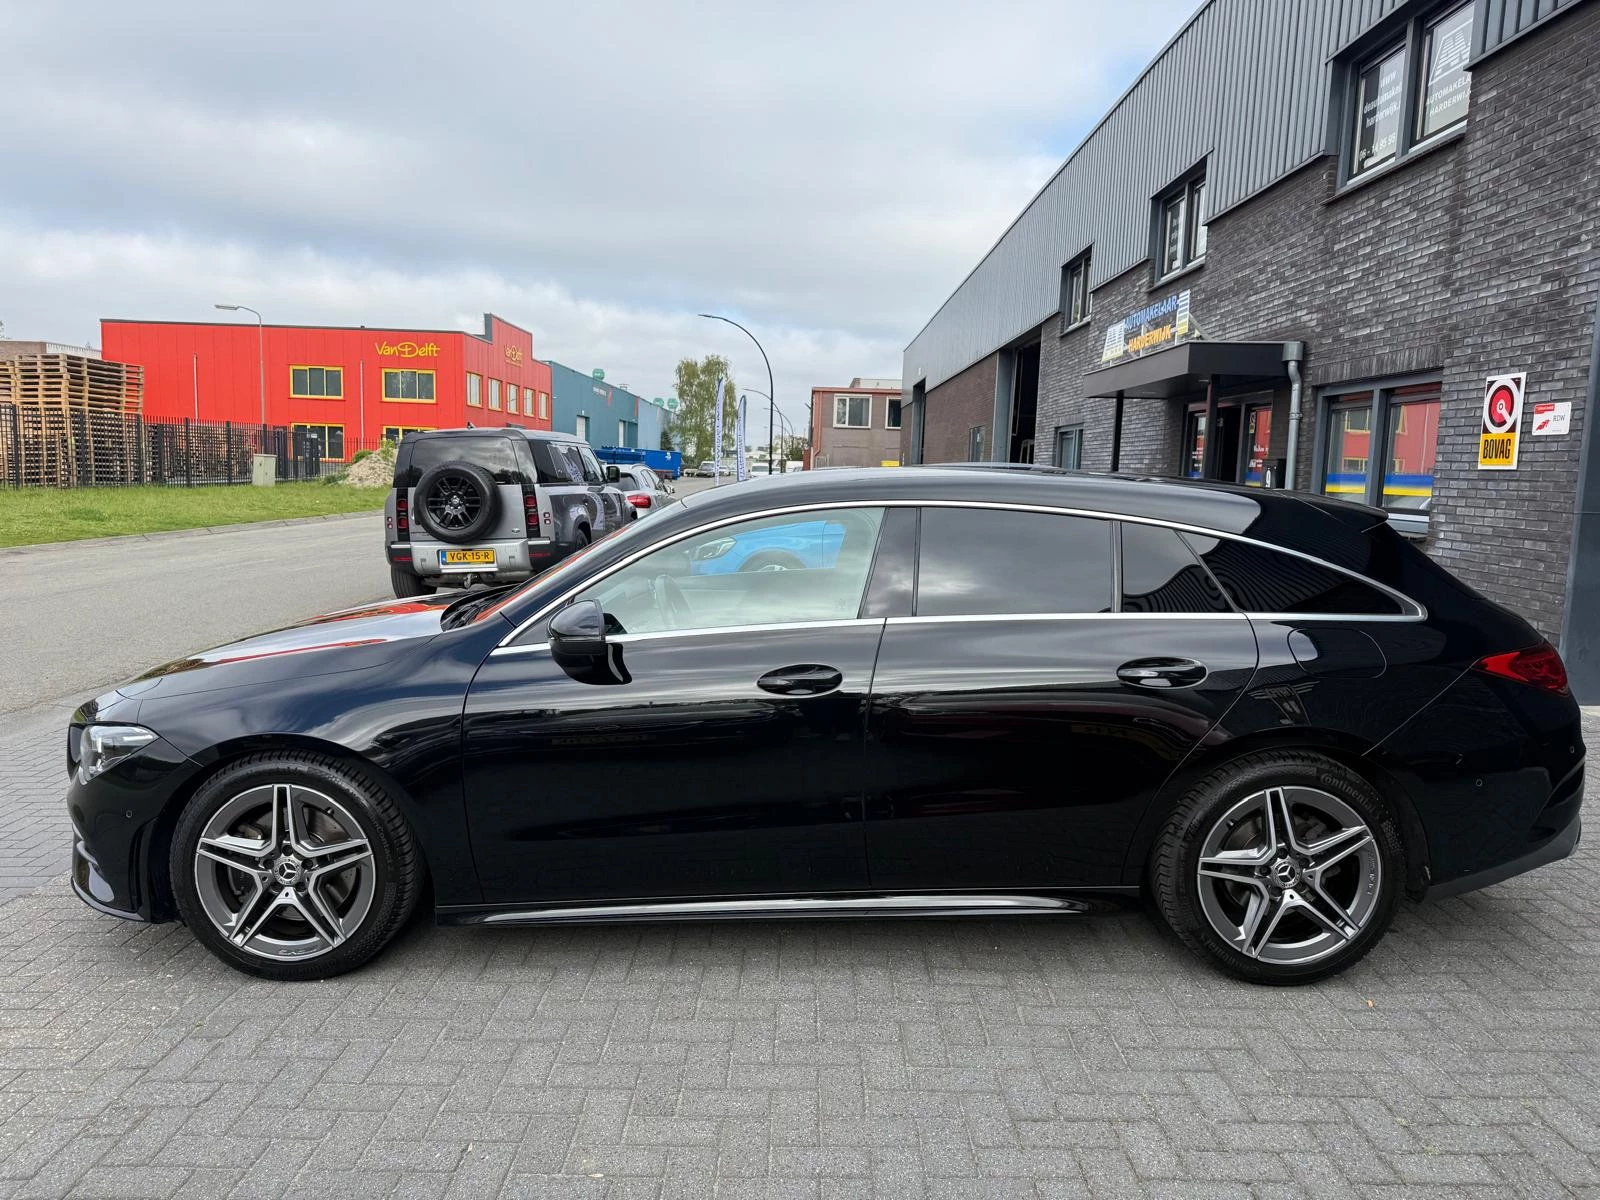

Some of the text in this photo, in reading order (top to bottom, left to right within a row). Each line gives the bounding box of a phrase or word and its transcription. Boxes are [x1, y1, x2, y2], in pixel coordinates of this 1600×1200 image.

[1124, 295, 1178, 330] AUTOMAKELAAR
[1483, 438, 1512, 460] BOVAG
[449, 551, 490, 561] VGK-15-R
